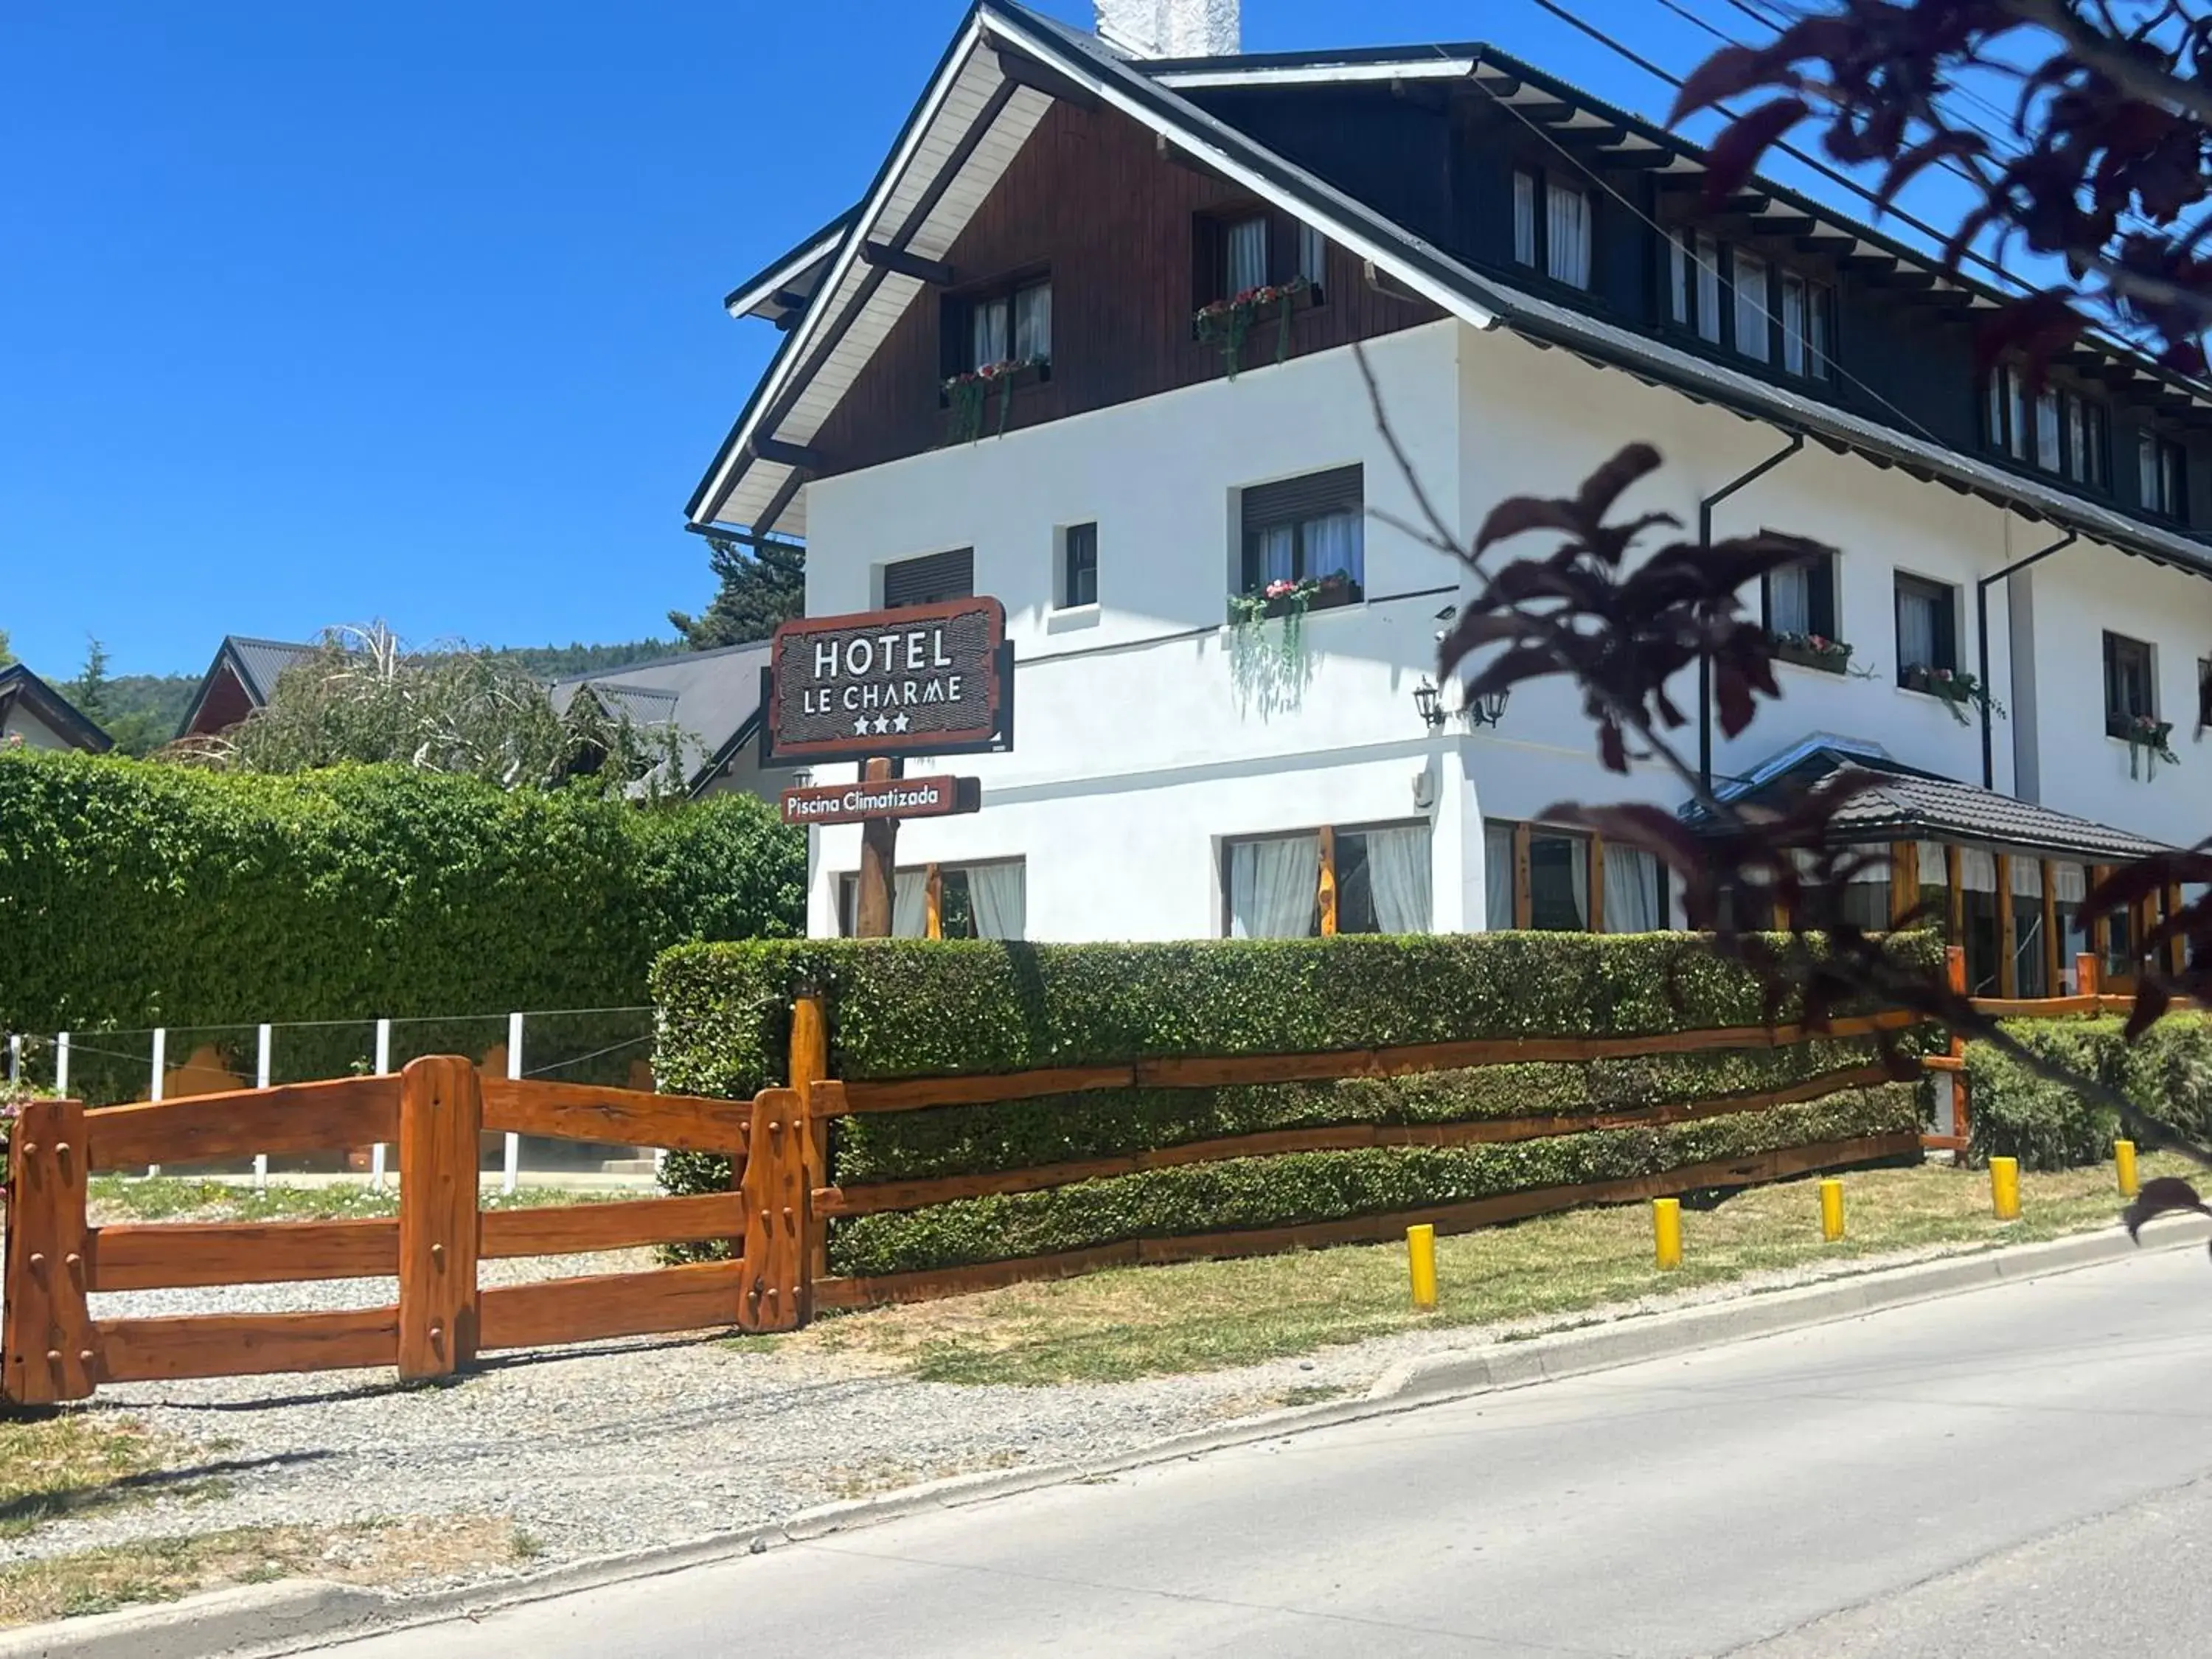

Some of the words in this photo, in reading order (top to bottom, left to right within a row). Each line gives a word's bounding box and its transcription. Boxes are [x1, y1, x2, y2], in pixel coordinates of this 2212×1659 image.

[814, 630, 952, 678] HOTEL
[804, 689, 831, 713] LE
[844, 676, 961, 710] CHARME
[787, 797, 839, 816] Piscina
[844, 785, 938, 810] Climatizada
